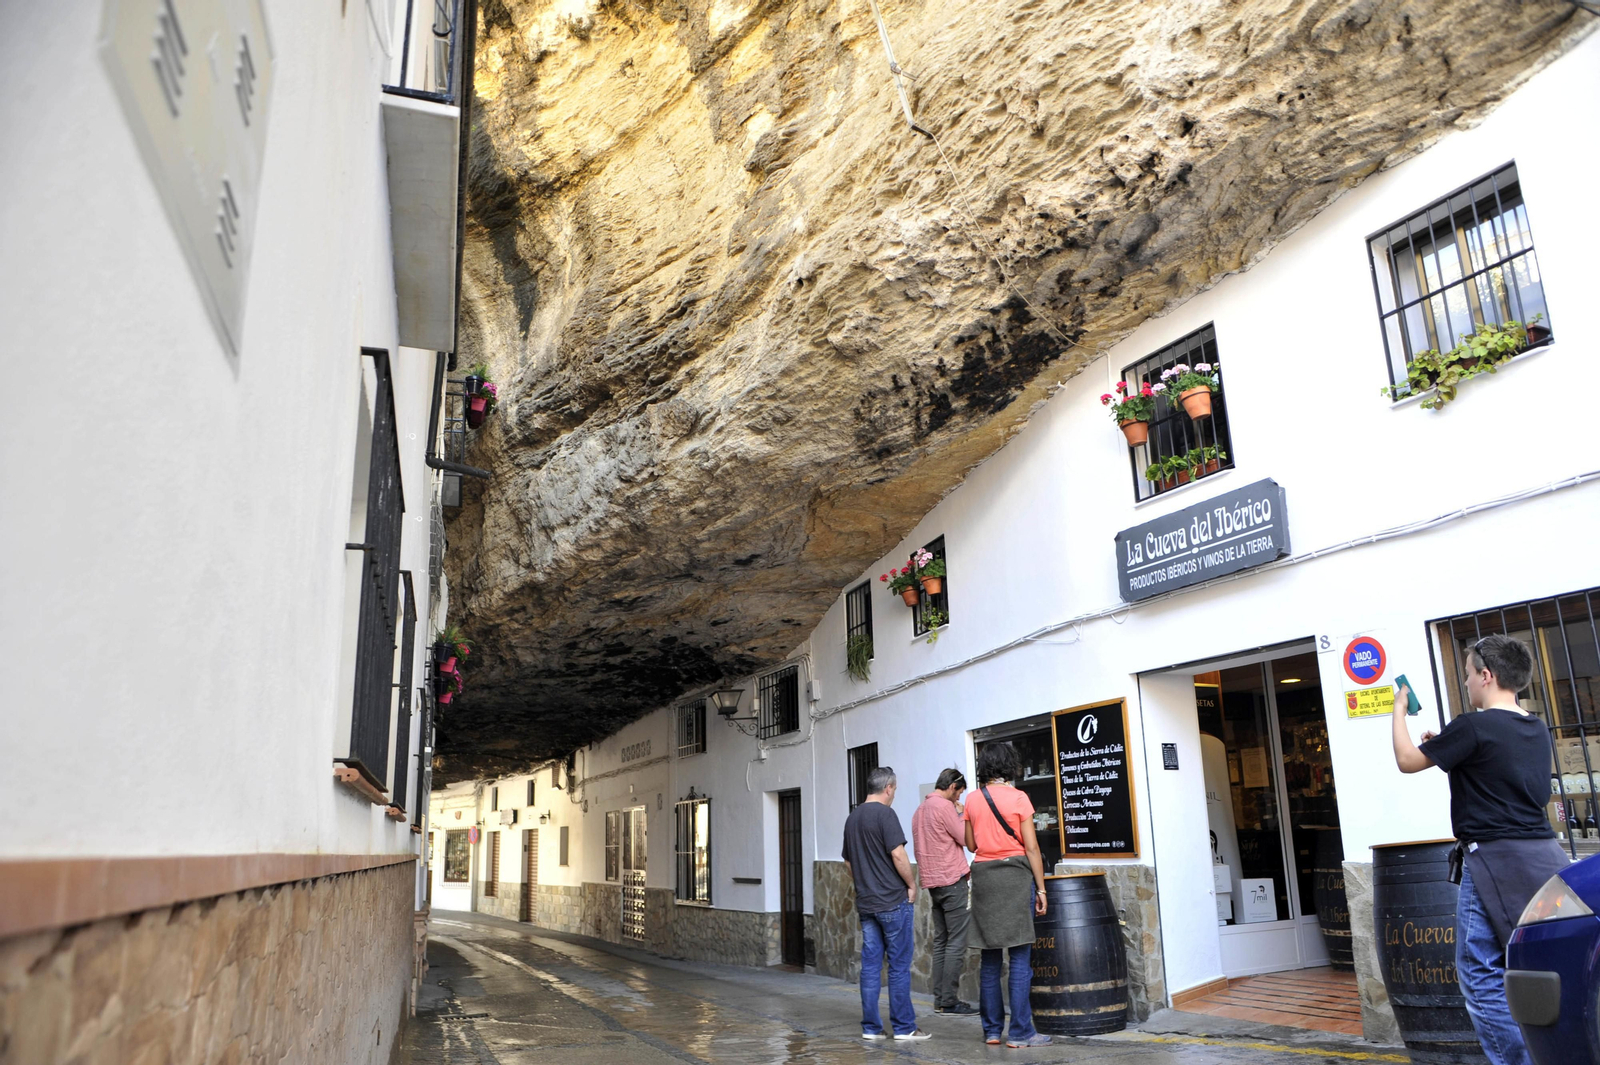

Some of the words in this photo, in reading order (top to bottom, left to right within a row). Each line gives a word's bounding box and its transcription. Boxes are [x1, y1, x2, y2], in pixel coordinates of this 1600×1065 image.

[1126, 540, 1144, 567] La
[1146, 532, 1188, 560] Cueva
[1190, 516, 1212, 546] del
[1214, 499, 1272, 537] Ibérico
[1130, 568, 1167, 591] PRODUCTOS
[1167, 562, 1197, 580] IBÉRICOS
[1197, 556, 1202, 570] Y
[1203, 550, 1224, 568] VINOS
[1225, 546, 1235, 562] DE
[1236, 544, 1246, 558] LA
[1246, 535, 1274, 555] TIERRA
[1320, 635, 1330, 650] 8
[1354, 650, 1372, 661] VADO
[1352, 658, 1378, 668] PERMANENTE
[1060, 751, 1079, 760] Productos
[1080, 749, 1084, 757] de
[1085, 748, 1089, 756] la
[1090, 747, 1104, 756] Sierra
[1105, 745, 1109, 754] de
[1061, 764, 1076, 774] Jamones
[1077, 765, 1080, 773] y
[1084, 773, 1099, 782] Tierra
[1063, 788, 1076, 799] Quesos
[1081, 786, 1094, 795] Cabra
[1327, 874, 1344, 890] Cue
[1251, 890, 1257, 904] 7
[1385, 923, 1400, 945] La
[1403, 921, 1455, 947] Cueva
[1032, 936, 1055, 949] ueva
